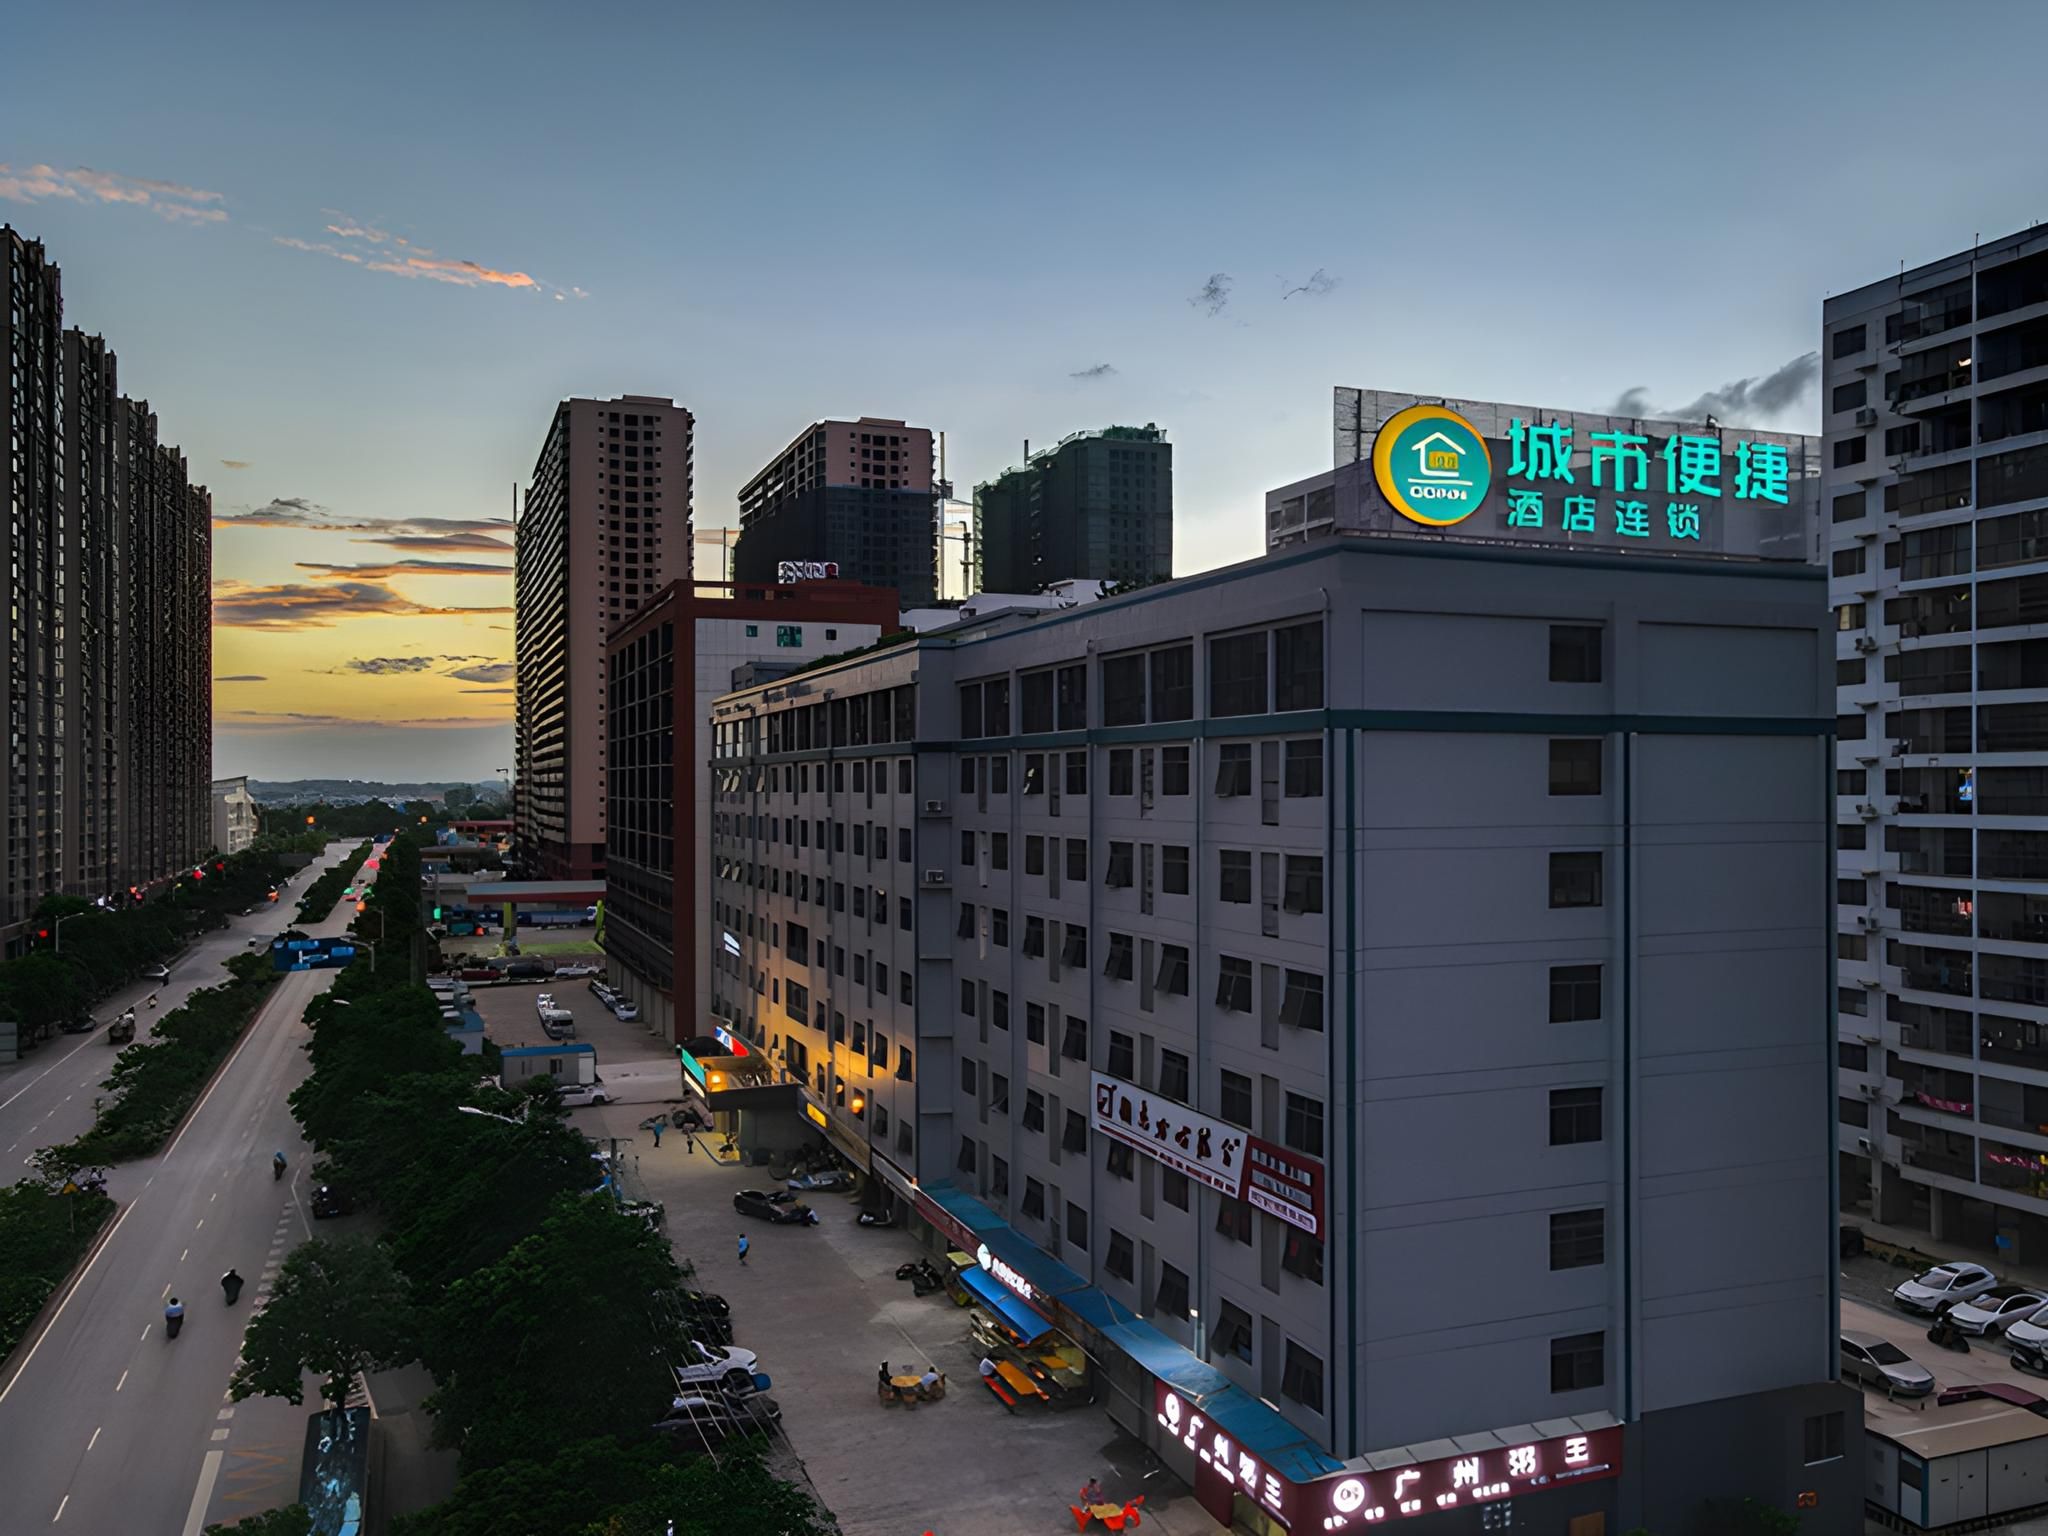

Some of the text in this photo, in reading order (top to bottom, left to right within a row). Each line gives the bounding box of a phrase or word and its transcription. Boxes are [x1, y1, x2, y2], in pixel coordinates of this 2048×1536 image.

[1507, 418, 1789, 505] 城市便捷
[1507, 488, 1700, 540] 酒店连锁
[1393, 1436, 1590, 1500] 广州粥王
